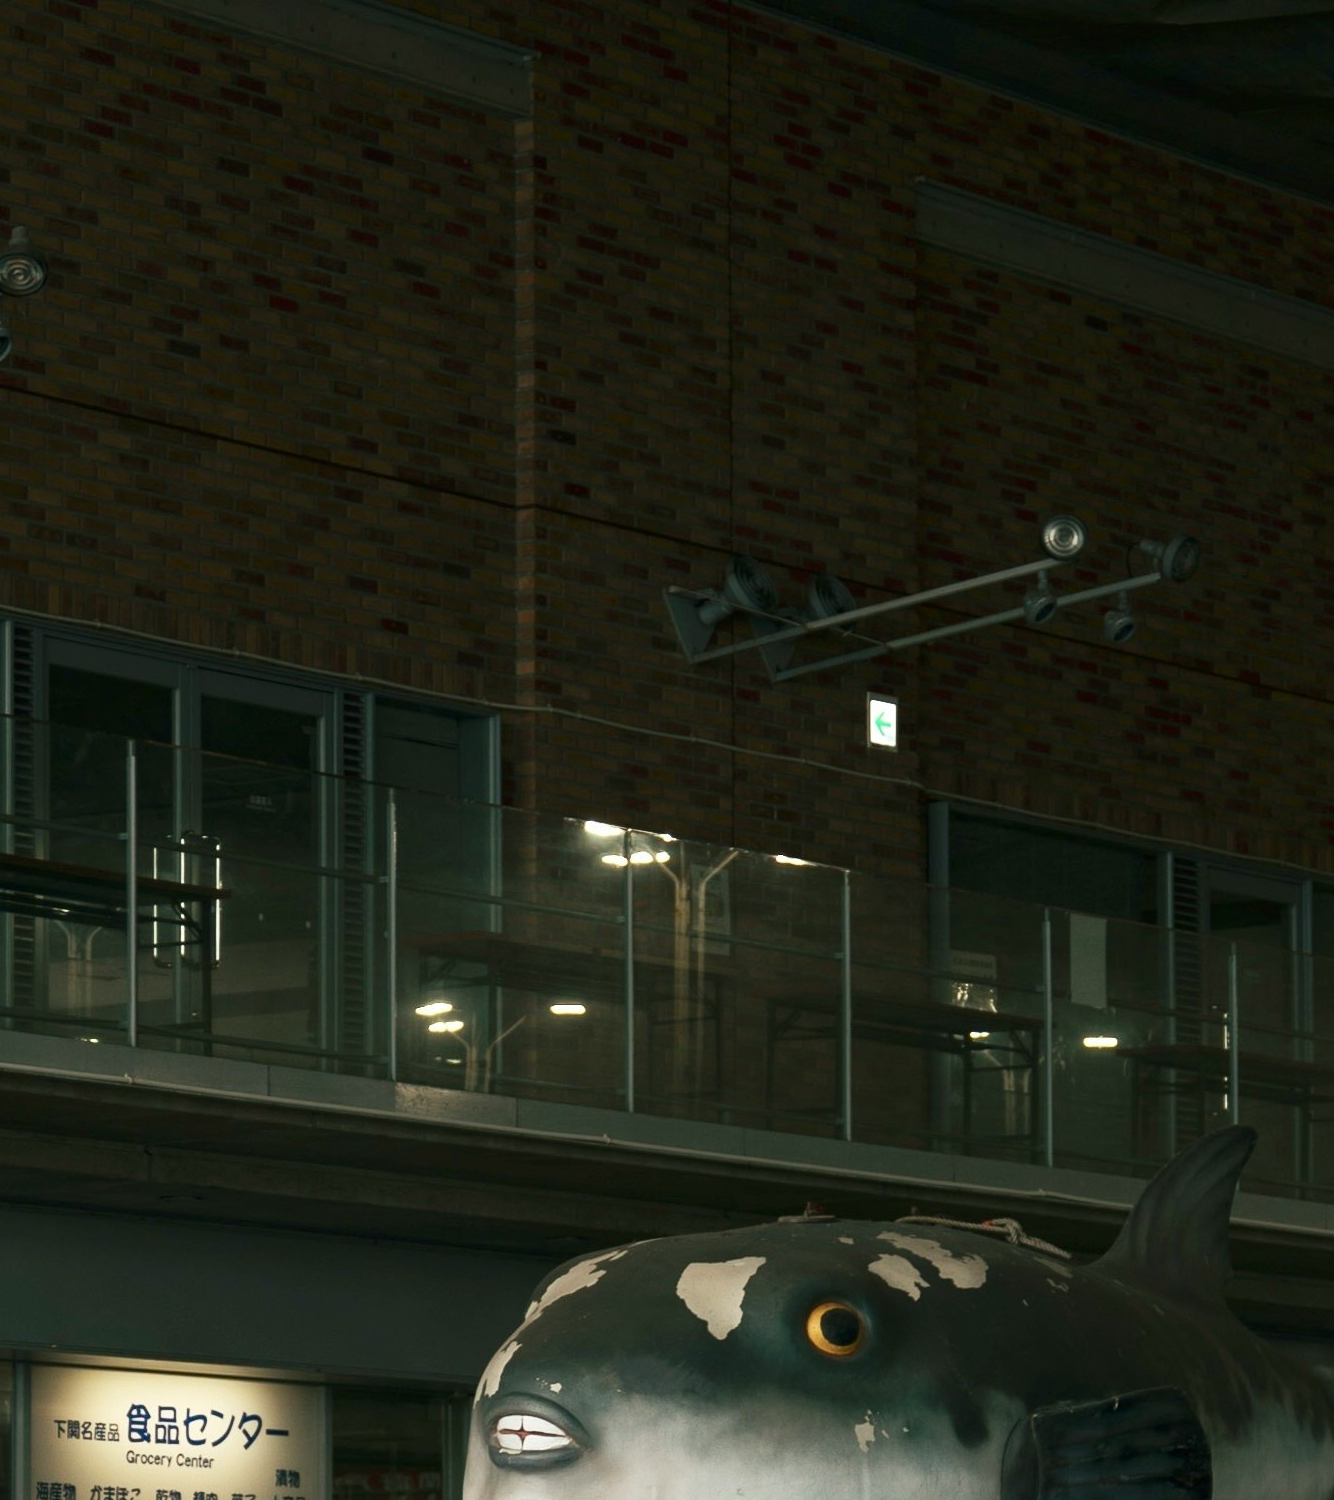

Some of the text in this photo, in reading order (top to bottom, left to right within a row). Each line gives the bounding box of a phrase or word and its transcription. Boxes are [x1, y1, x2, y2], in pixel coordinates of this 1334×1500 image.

[53, 1403, 290, 1450] 下関名産品 食品センター
[126, 1450, 215, 1469] Grocery Center
